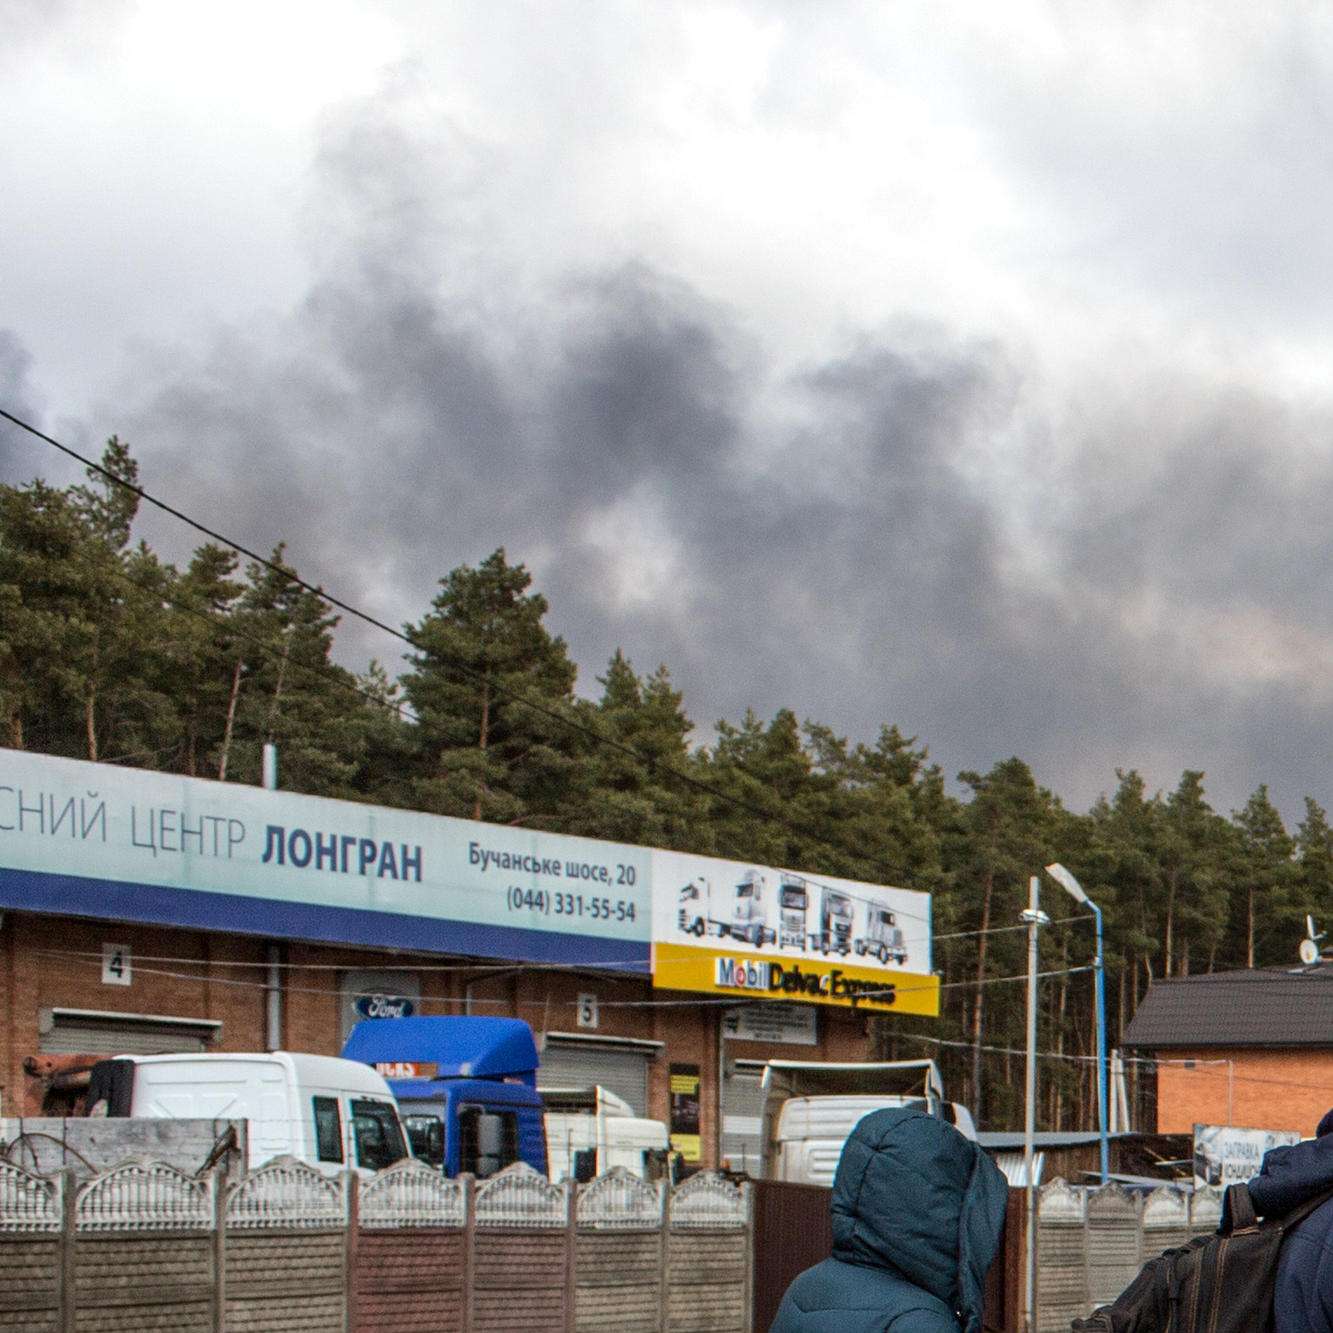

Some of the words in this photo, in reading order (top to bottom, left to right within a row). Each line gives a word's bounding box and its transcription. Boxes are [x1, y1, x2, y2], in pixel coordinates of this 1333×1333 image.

[130, 805, 246, 859] ЦЕНТР
[261, 824, 422, 883] ЛОНГРАН
[468, 841, 562, 876] Бучанське
[566, 861, 612, 886] шосе,
[616, 864, 636, 886] 20
[507, 885, 550, 915] (044)
[554, 892, 635, 922] 331-55-54
[110, 950, 123, 978] 4
[717, 957, 769, 990] Mobil
[582, 999, 592, 1022] 5
